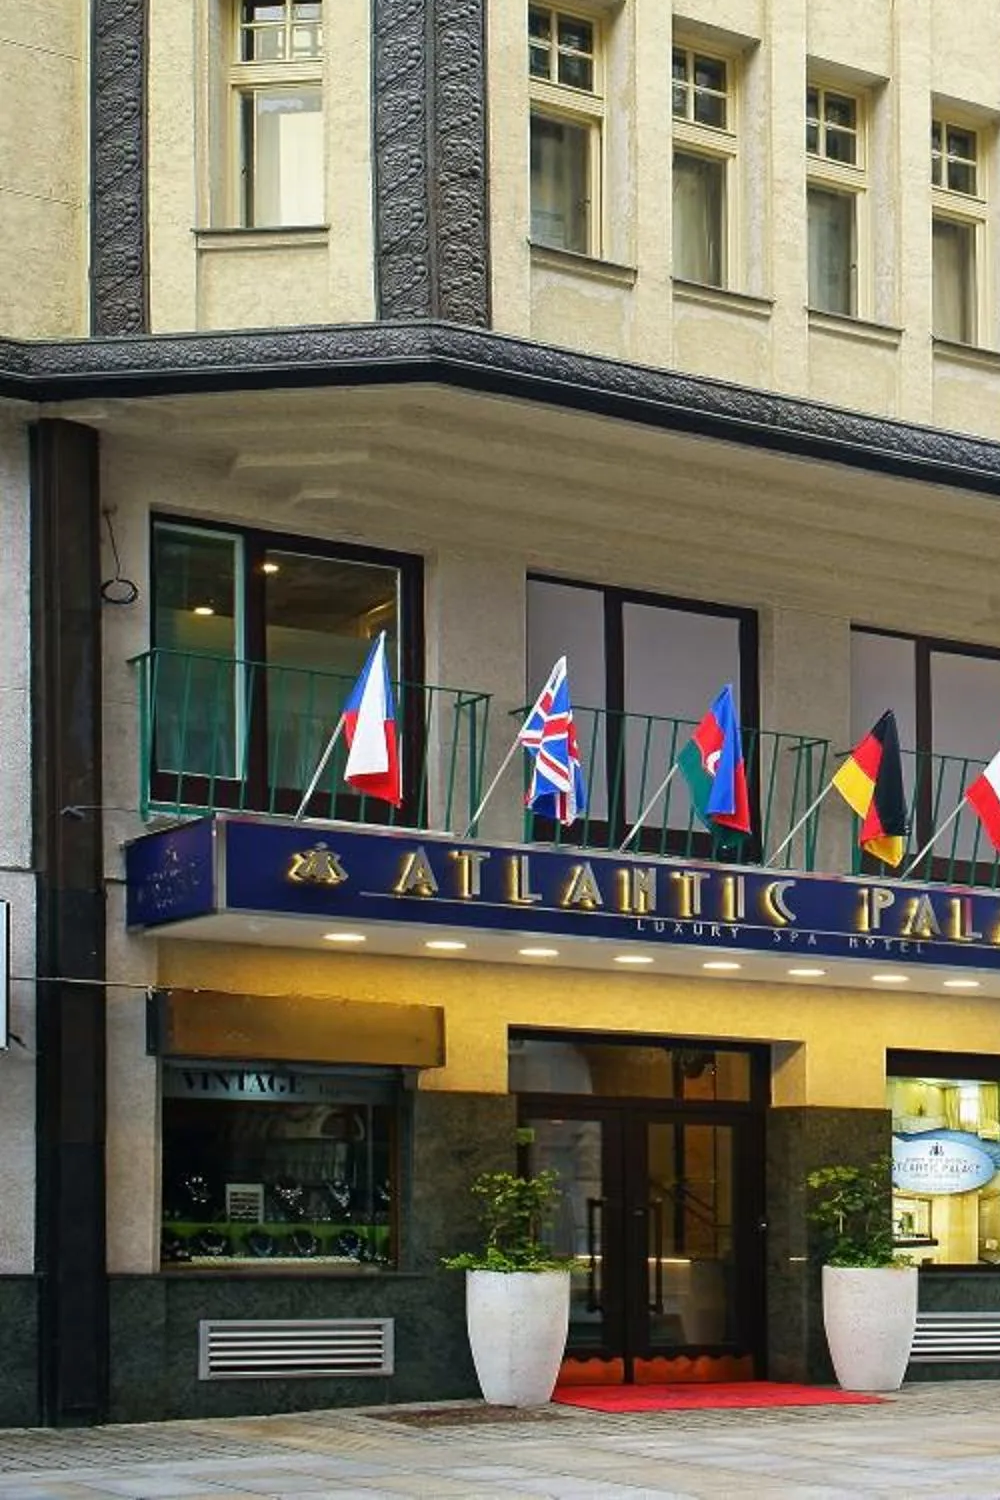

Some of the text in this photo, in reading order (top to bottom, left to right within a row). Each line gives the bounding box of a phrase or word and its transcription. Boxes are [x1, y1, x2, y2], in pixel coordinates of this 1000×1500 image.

[394, 846, 798, 928] ATLANTIC
[635, 919, 923, 954] LUXURY SPA HOTEL
[181, 1070, 305, 1095] VINTAGE
